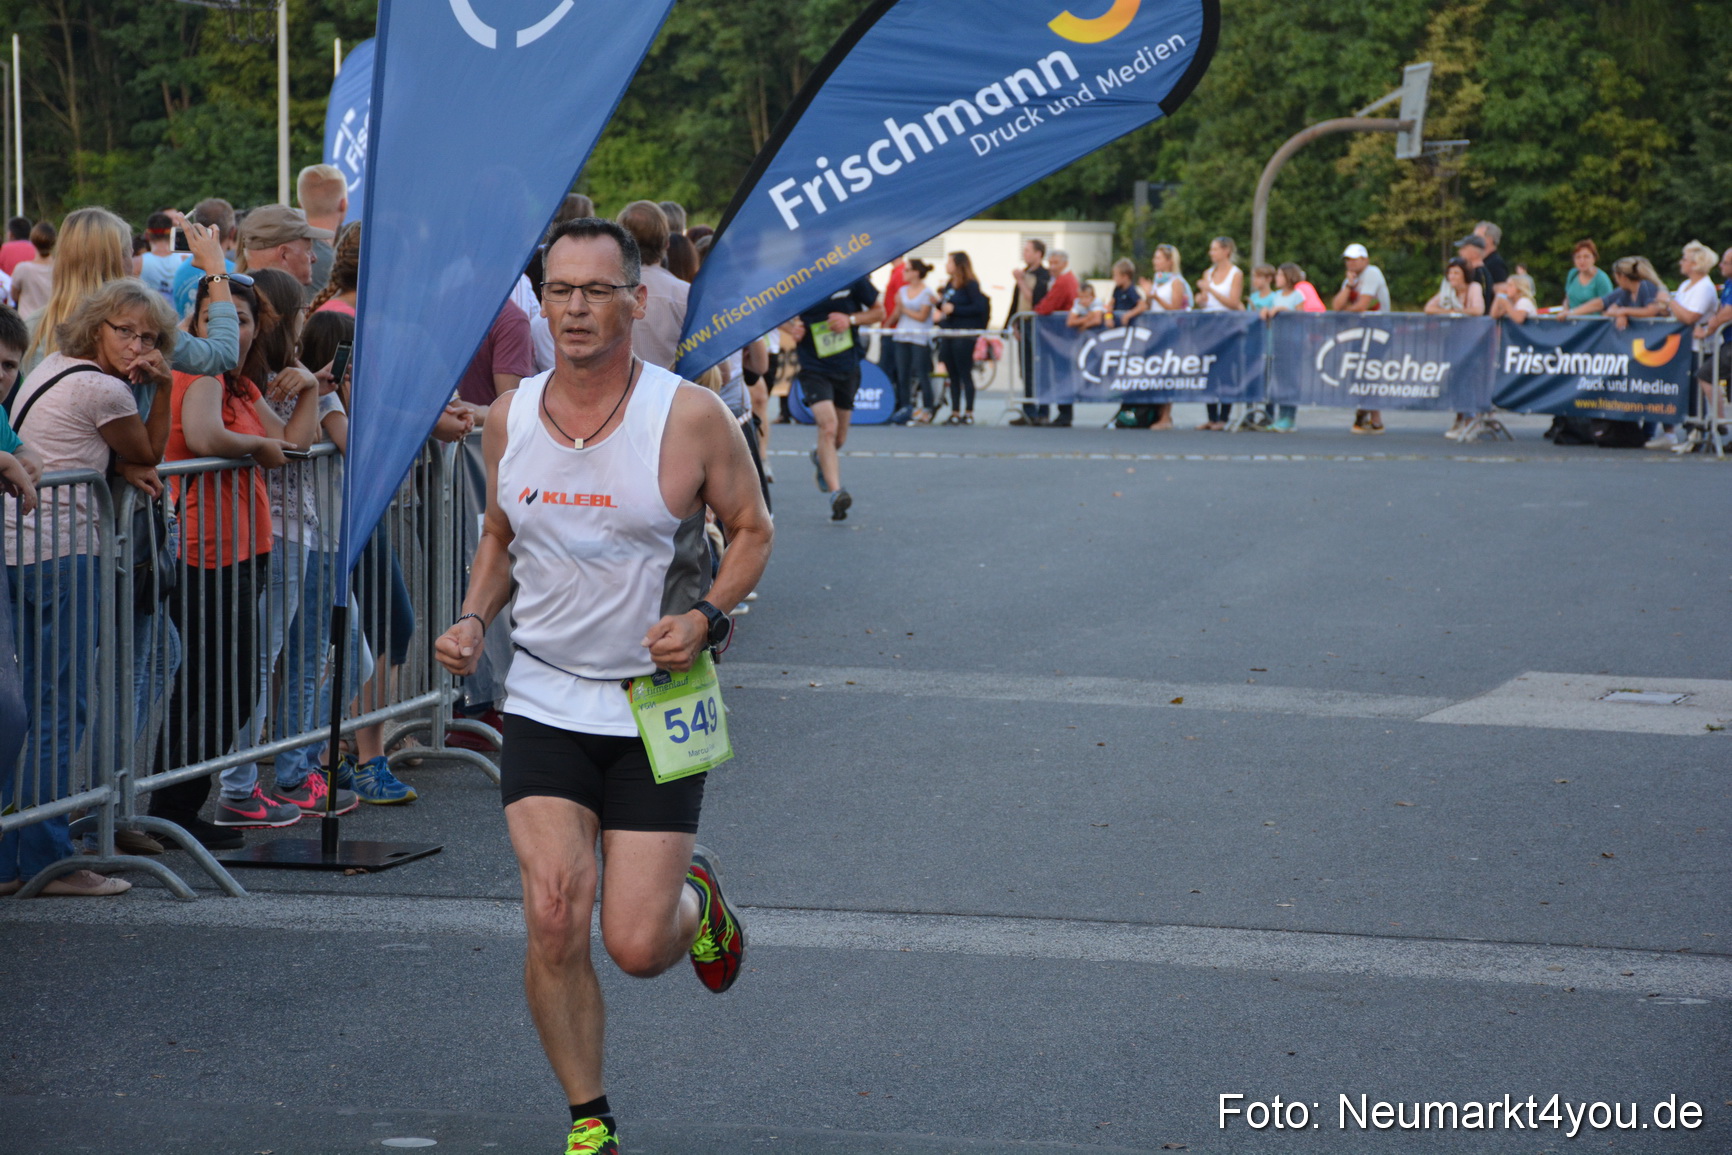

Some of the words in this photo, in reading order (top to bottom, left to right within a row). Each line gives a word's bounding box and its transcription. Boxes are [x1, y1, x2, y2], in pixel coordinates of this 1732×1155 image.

[969, 102, 1045, 157] Druck
[1047, 82, 1097, 116] und
[1096, 32, 1187, 95] Medien
[768, 49, 1081, 231] Frischmann
[1101, 348, 1217, 377] Fischer
[1340, 353, 1451, 382] Fischer
[1503, 345, 1630, 376] Frischmann
[1109, 376, 1208, 391] AUTOMOBILE
[1348, 382, 1441, 398] AUTOMOBILE
[1576, 376, 1604, 391] Druck
[1607, 378, 1628, 392] und
[1630, 379, 1679, 395] Medien
[542, 490, 618, 509] KLEBL
[664, 696, 718, 744] 549
